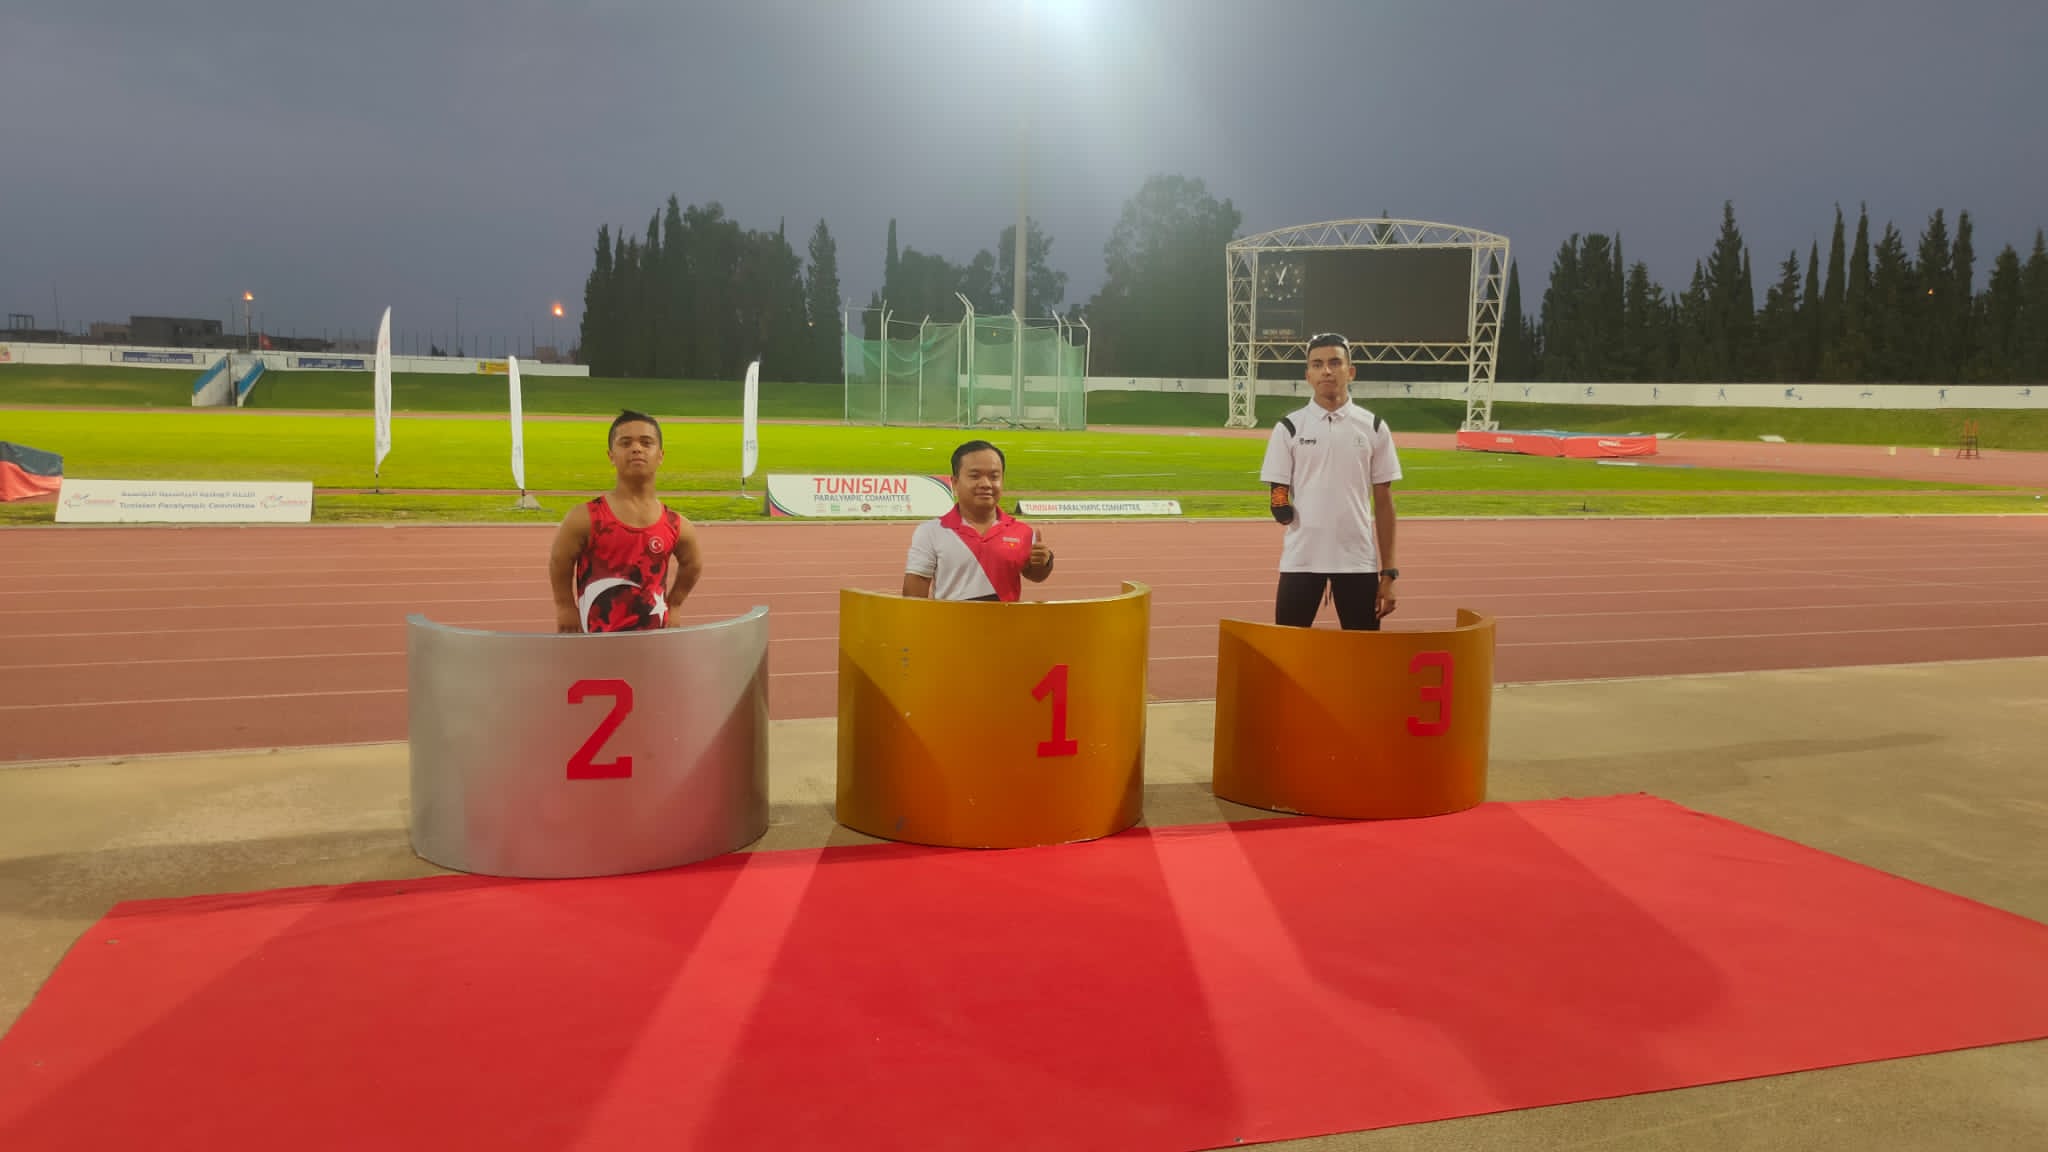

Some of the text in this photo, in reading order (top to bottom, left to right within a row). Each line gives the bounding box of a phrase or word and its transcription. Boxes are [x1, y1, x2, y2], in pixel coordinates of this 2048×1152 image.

[813, 477, 908, 494] TUNISIAN
[814, 494, 911, 502] PARALYMPIC COMMITTEE
[566, 680, 634, 780] 2
[1031, 665, 1078, 757] 1
[1407, 652, 1452, 736] 3
